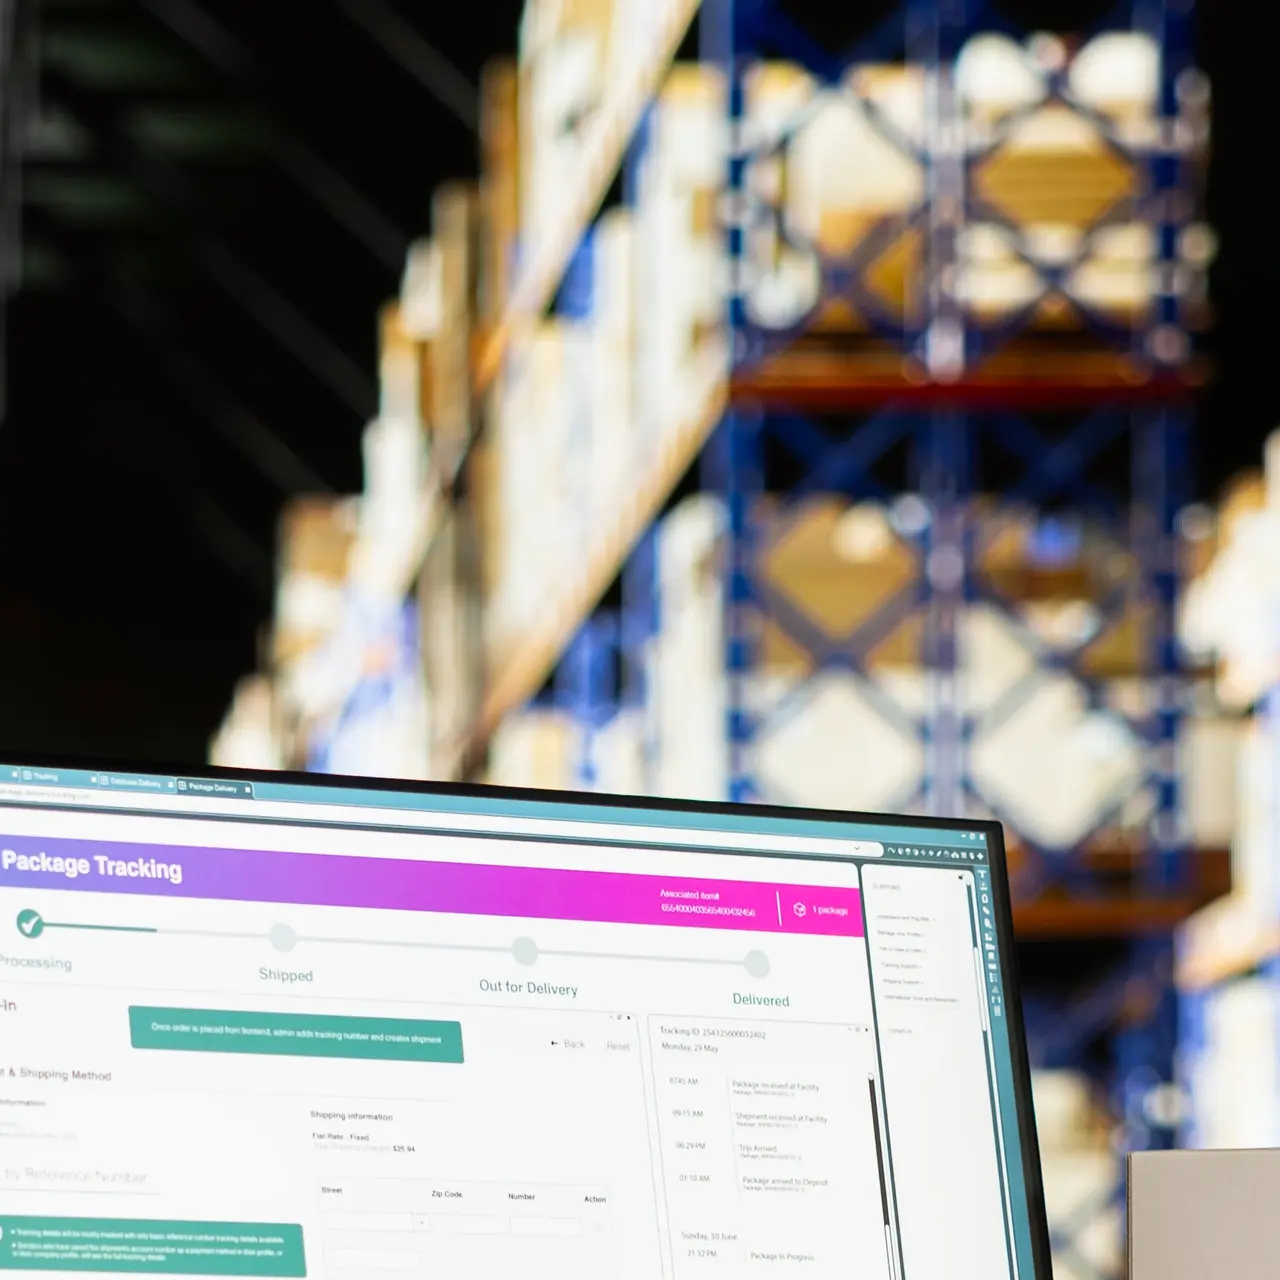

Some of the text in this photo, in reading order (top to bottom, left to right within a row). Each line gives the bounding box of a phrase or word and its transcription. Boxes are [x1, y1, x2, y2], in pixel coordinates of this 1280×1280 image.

[1, 848, 90, 879] Package
[95, 855, 183, 885] Tracking
[818, 906, 849, 917] package
[259, 967, 314, 984] Shipped
[479, 979, 579, 998] Out for Delivery
[733, 992, 790, 1008] Delivered
[660, 1026, 690, 1038] Tracking
[564, 1038, 631, 1052] Back Reset
[704, 1044, 719, 1055] May
[9, 1067, 16, 1077] &
[20, 1067, 69, 1082] Shipping
[72, 1070, 111, 1082] Method
[686, 1077, 699, 1086] AM
[732, 1080, 760, 1092] Package
[310, 1110, 346, 1121] Shipping
[691, 1109, 704, 1118] AM
[753, 1145, 778, 1154] Arrived
[697, 1174, 711, 1183] AM
[742, 1176, 770, 1187] Package
[431, 1190, 443, 1199] Zip
[444, 1191, 463, 1199] Code
[508, 1193, 536, 1201] Number
[584, 1195, 607, 1204] Action
[721, 1232, 738, 1242] June
[750, 1251, 777, 1262] Package
